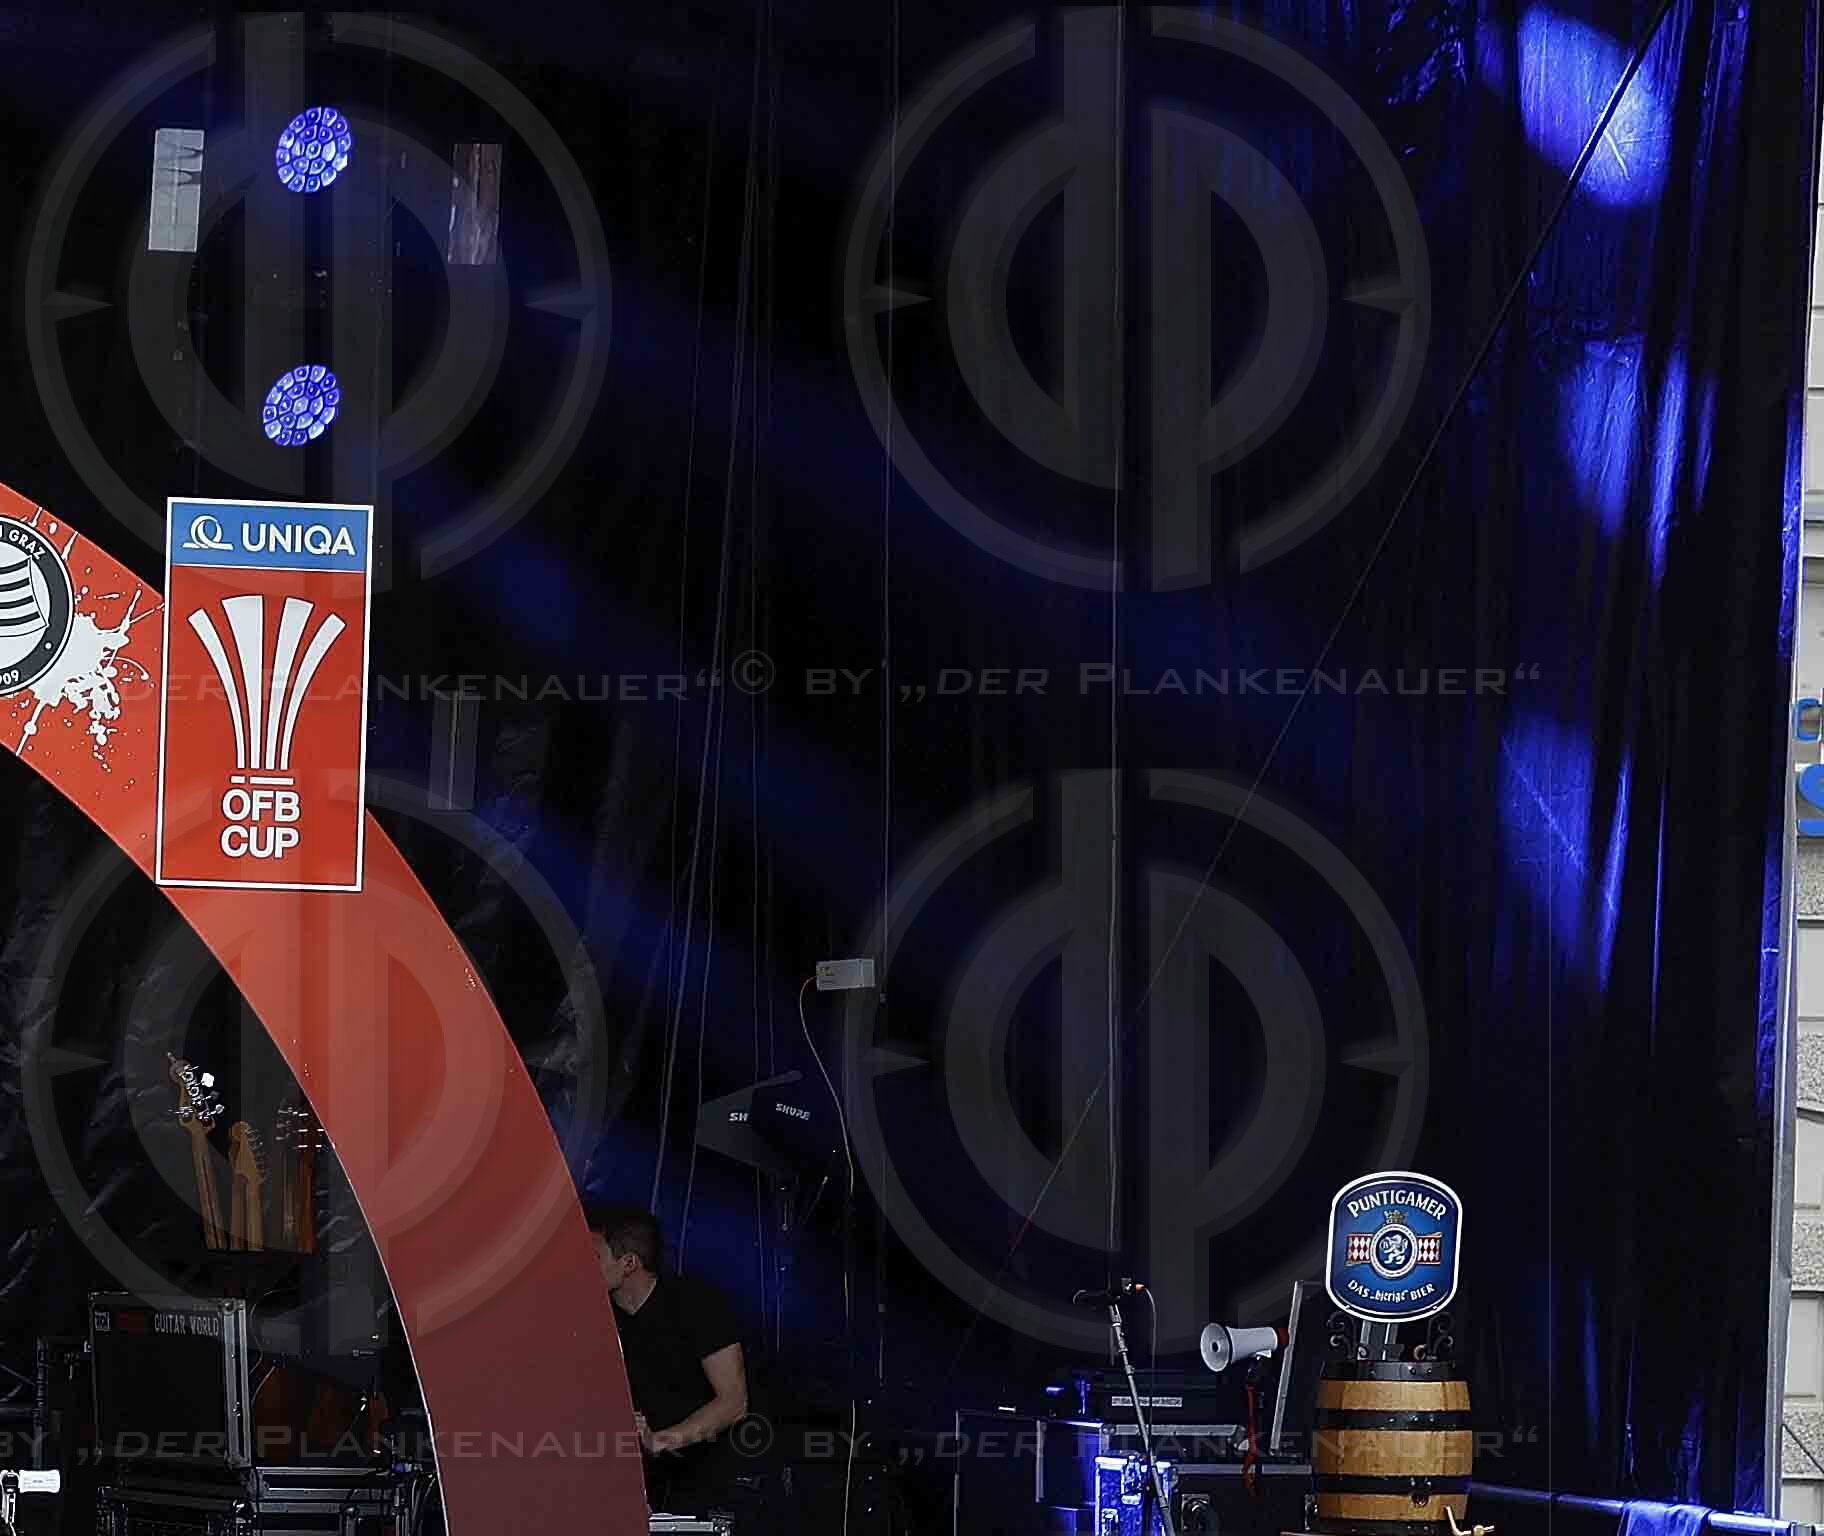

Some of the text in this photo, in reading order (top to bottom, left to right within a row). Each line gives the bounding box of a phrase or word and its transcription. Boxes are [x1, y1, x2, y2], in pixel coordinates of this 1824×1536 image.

[8, 528, 47, 560] GRAZ
[241, 523, 355, 555] UNIQA
[220, 825, 300, 859] CUP
[775, 1103, 811, 1121] SHURE
[1347, 1189, 1447, 1221] PUNTIGAMER
[1347, 1279, 1370, 1299] DAS
[1410, 1283, 1435, 1301] BIER
[154, 1313, 220, 1337] GUITAR WORLD
